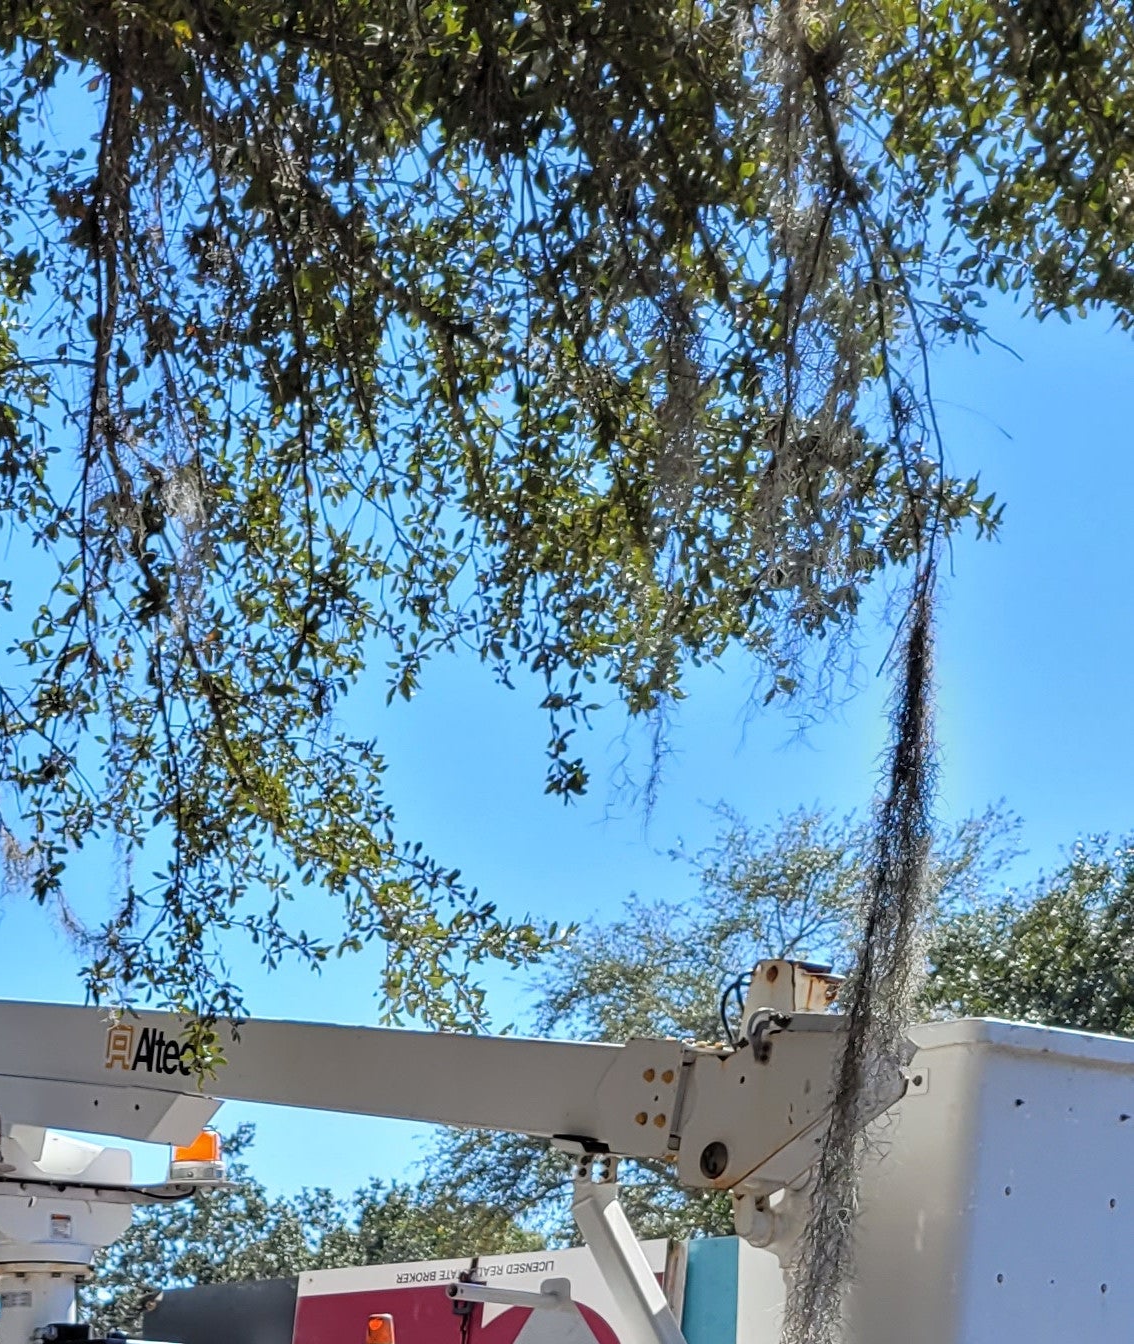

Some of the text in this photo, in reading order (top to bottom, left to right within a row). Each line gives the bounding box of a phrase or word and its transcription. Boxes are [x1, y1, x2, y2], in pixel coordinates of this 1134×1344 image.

[131, 1027, 197, 1076] Altec
[506, 1260, 555, 1275] LICENSED
[396, 1271, 437, 1284] BROKER
